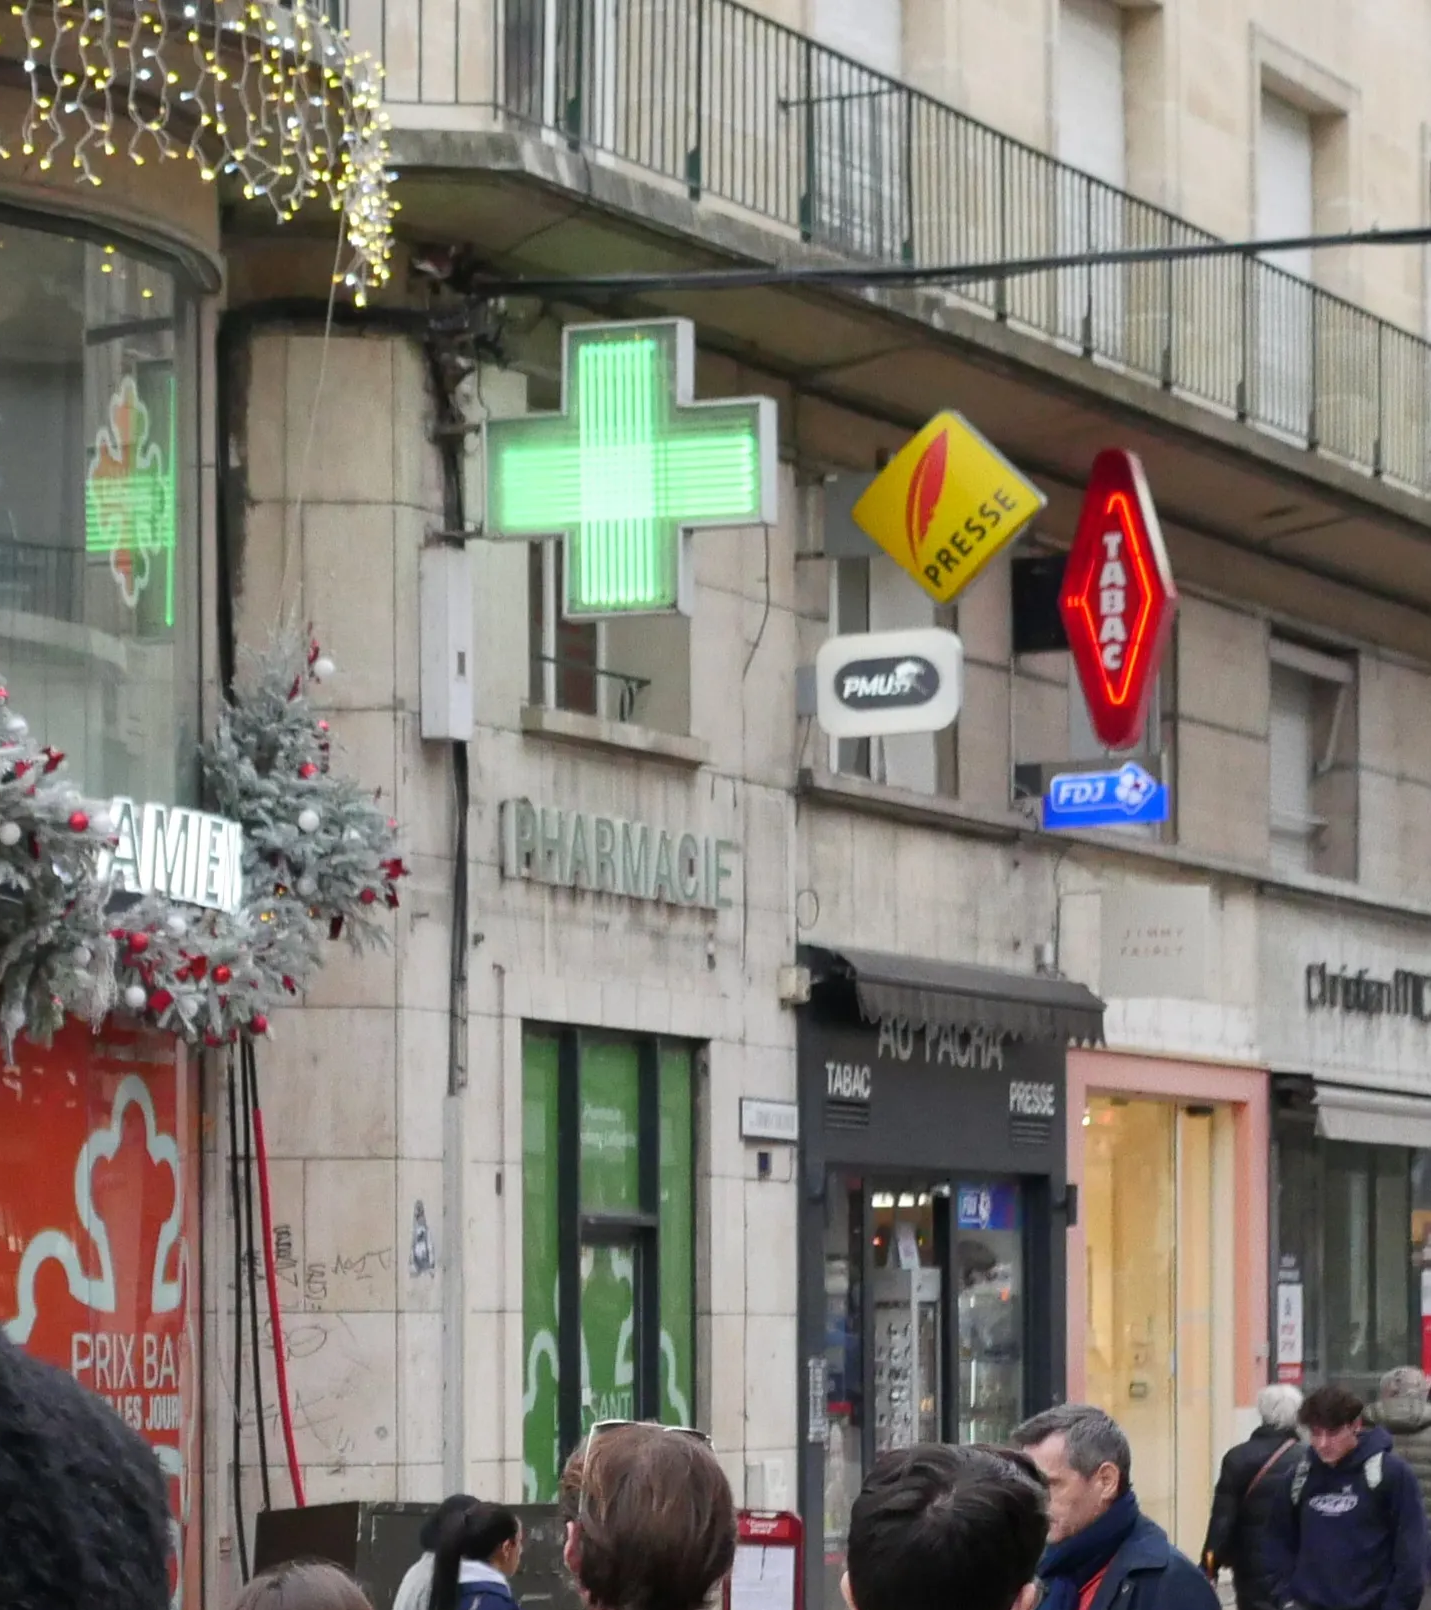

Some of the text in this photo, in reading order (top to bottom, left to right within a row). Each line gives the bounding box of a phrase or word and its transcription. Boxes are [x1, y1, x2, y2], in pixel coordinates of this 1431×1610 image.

[923, 488, 1017, 588] PRESSE
[1099, 531, 1127, 671] TABAC
[843, 672, 894, 700] PMU
[1058, 780, 1106, 806] FDJ
[504, 798, 742, 908] PHARMACIE
[825, 1061, 872, 1099] TABAC
[1008, 1081, 1056, 1116] PRESSE
[71, 1331, 179, 1389] PRIX BA
[145, 1394, 183, 1432] JOUR
